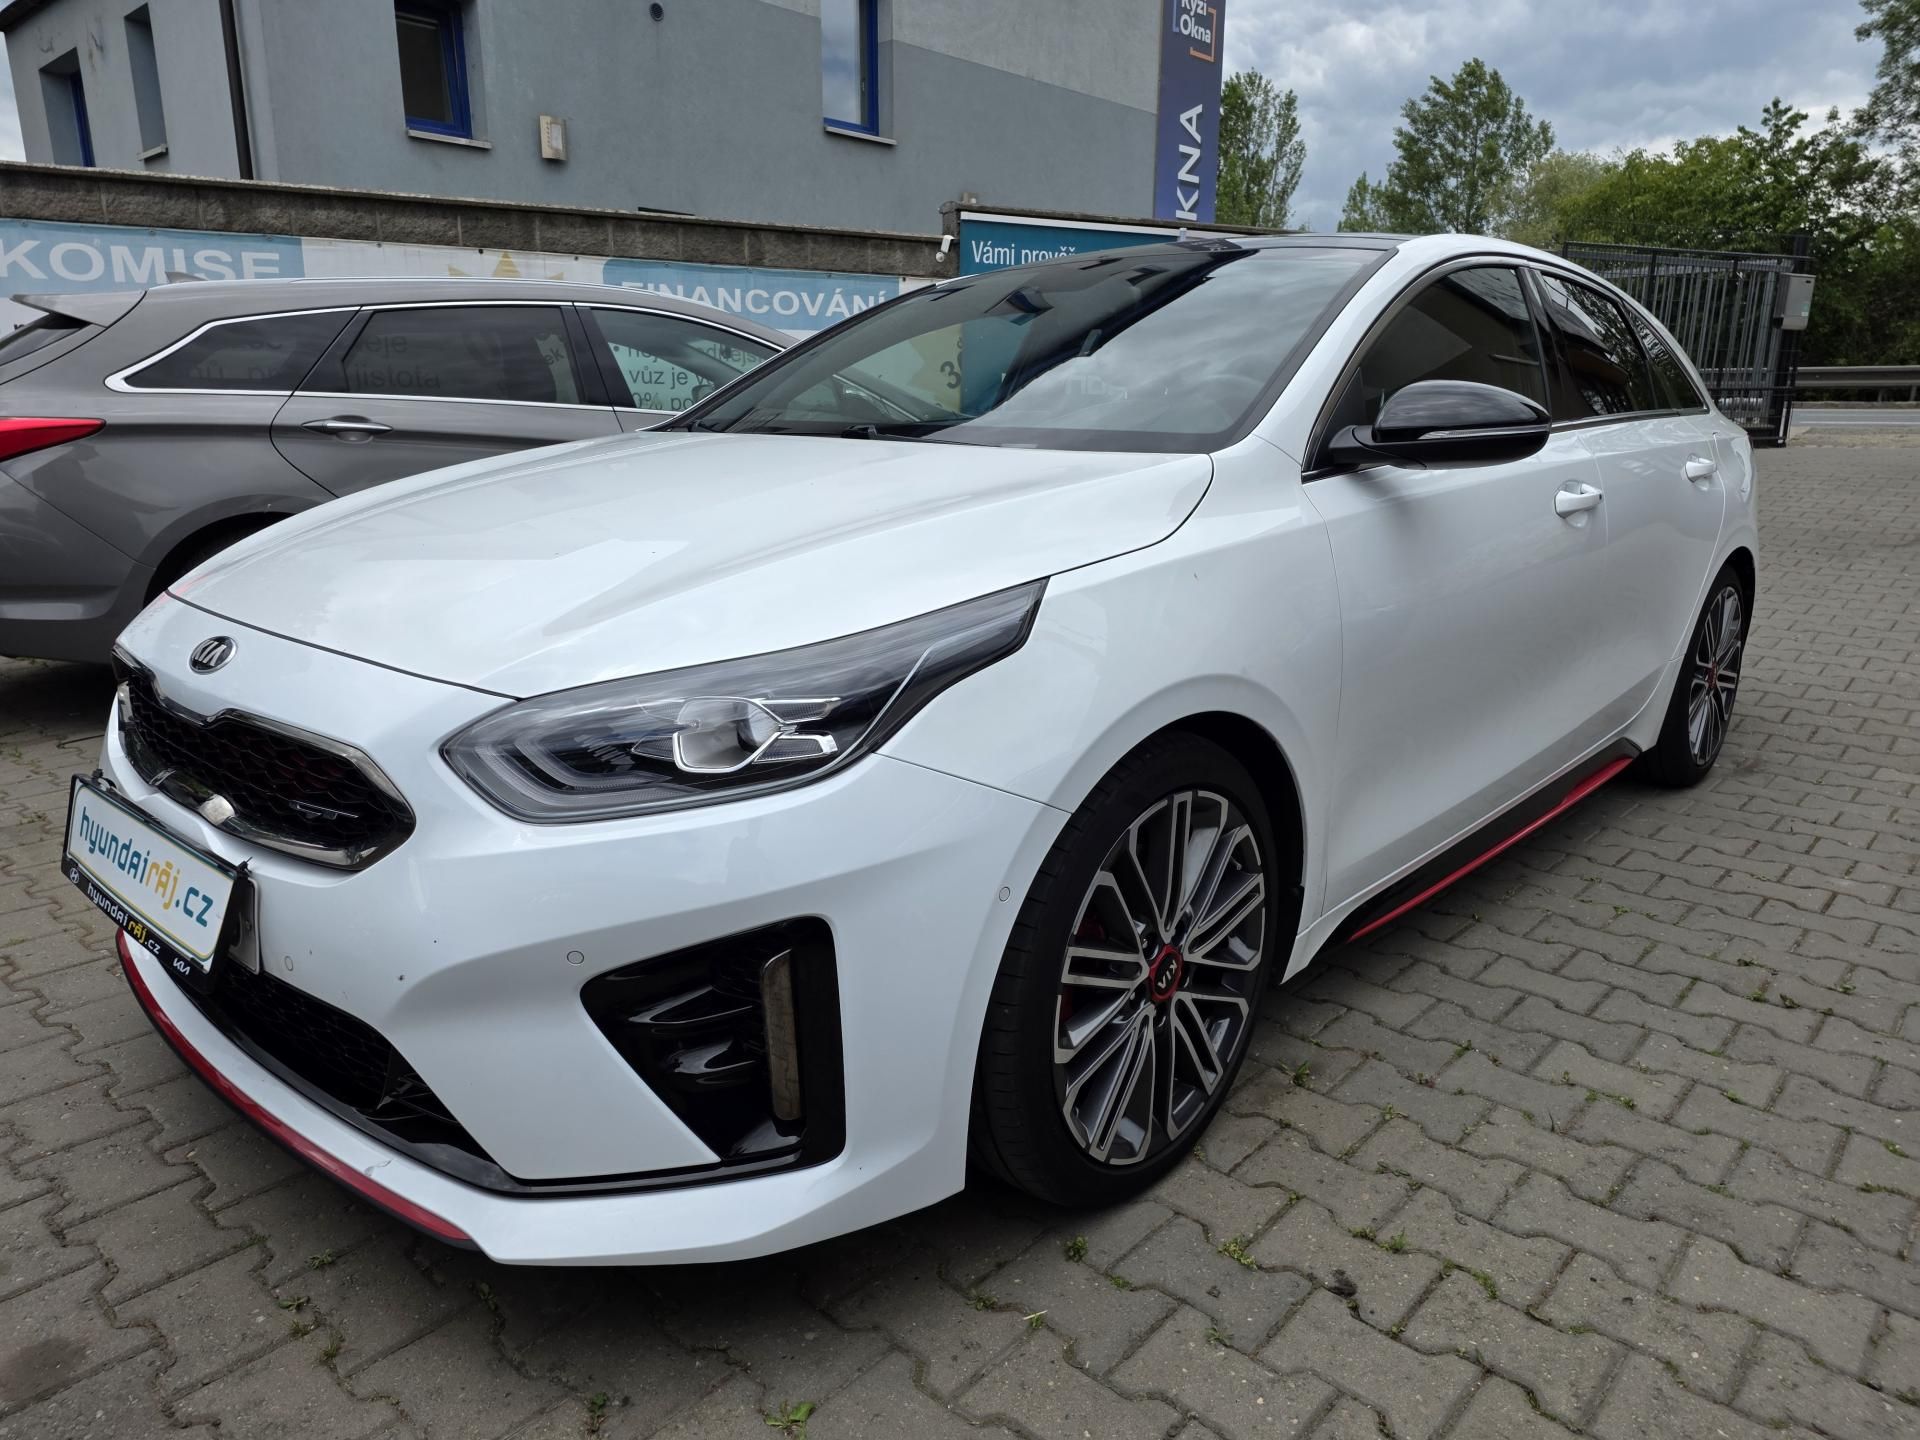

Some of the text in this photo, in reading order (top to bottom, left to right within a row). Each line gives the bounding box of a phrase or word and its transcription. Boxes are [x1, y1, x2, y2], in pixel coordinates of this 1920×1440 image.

[1180, 14, 1211, 43] Okna
[0, 238, 280, 284] KOMISE
[971, 239, 1015, 266] Vámi
[621, 281, 887, 318] ANCOVÁN
[629, 366, 664, 385] vůz
[670, 367, 688, 389] je
[191, 640, 228, 667] KIA
